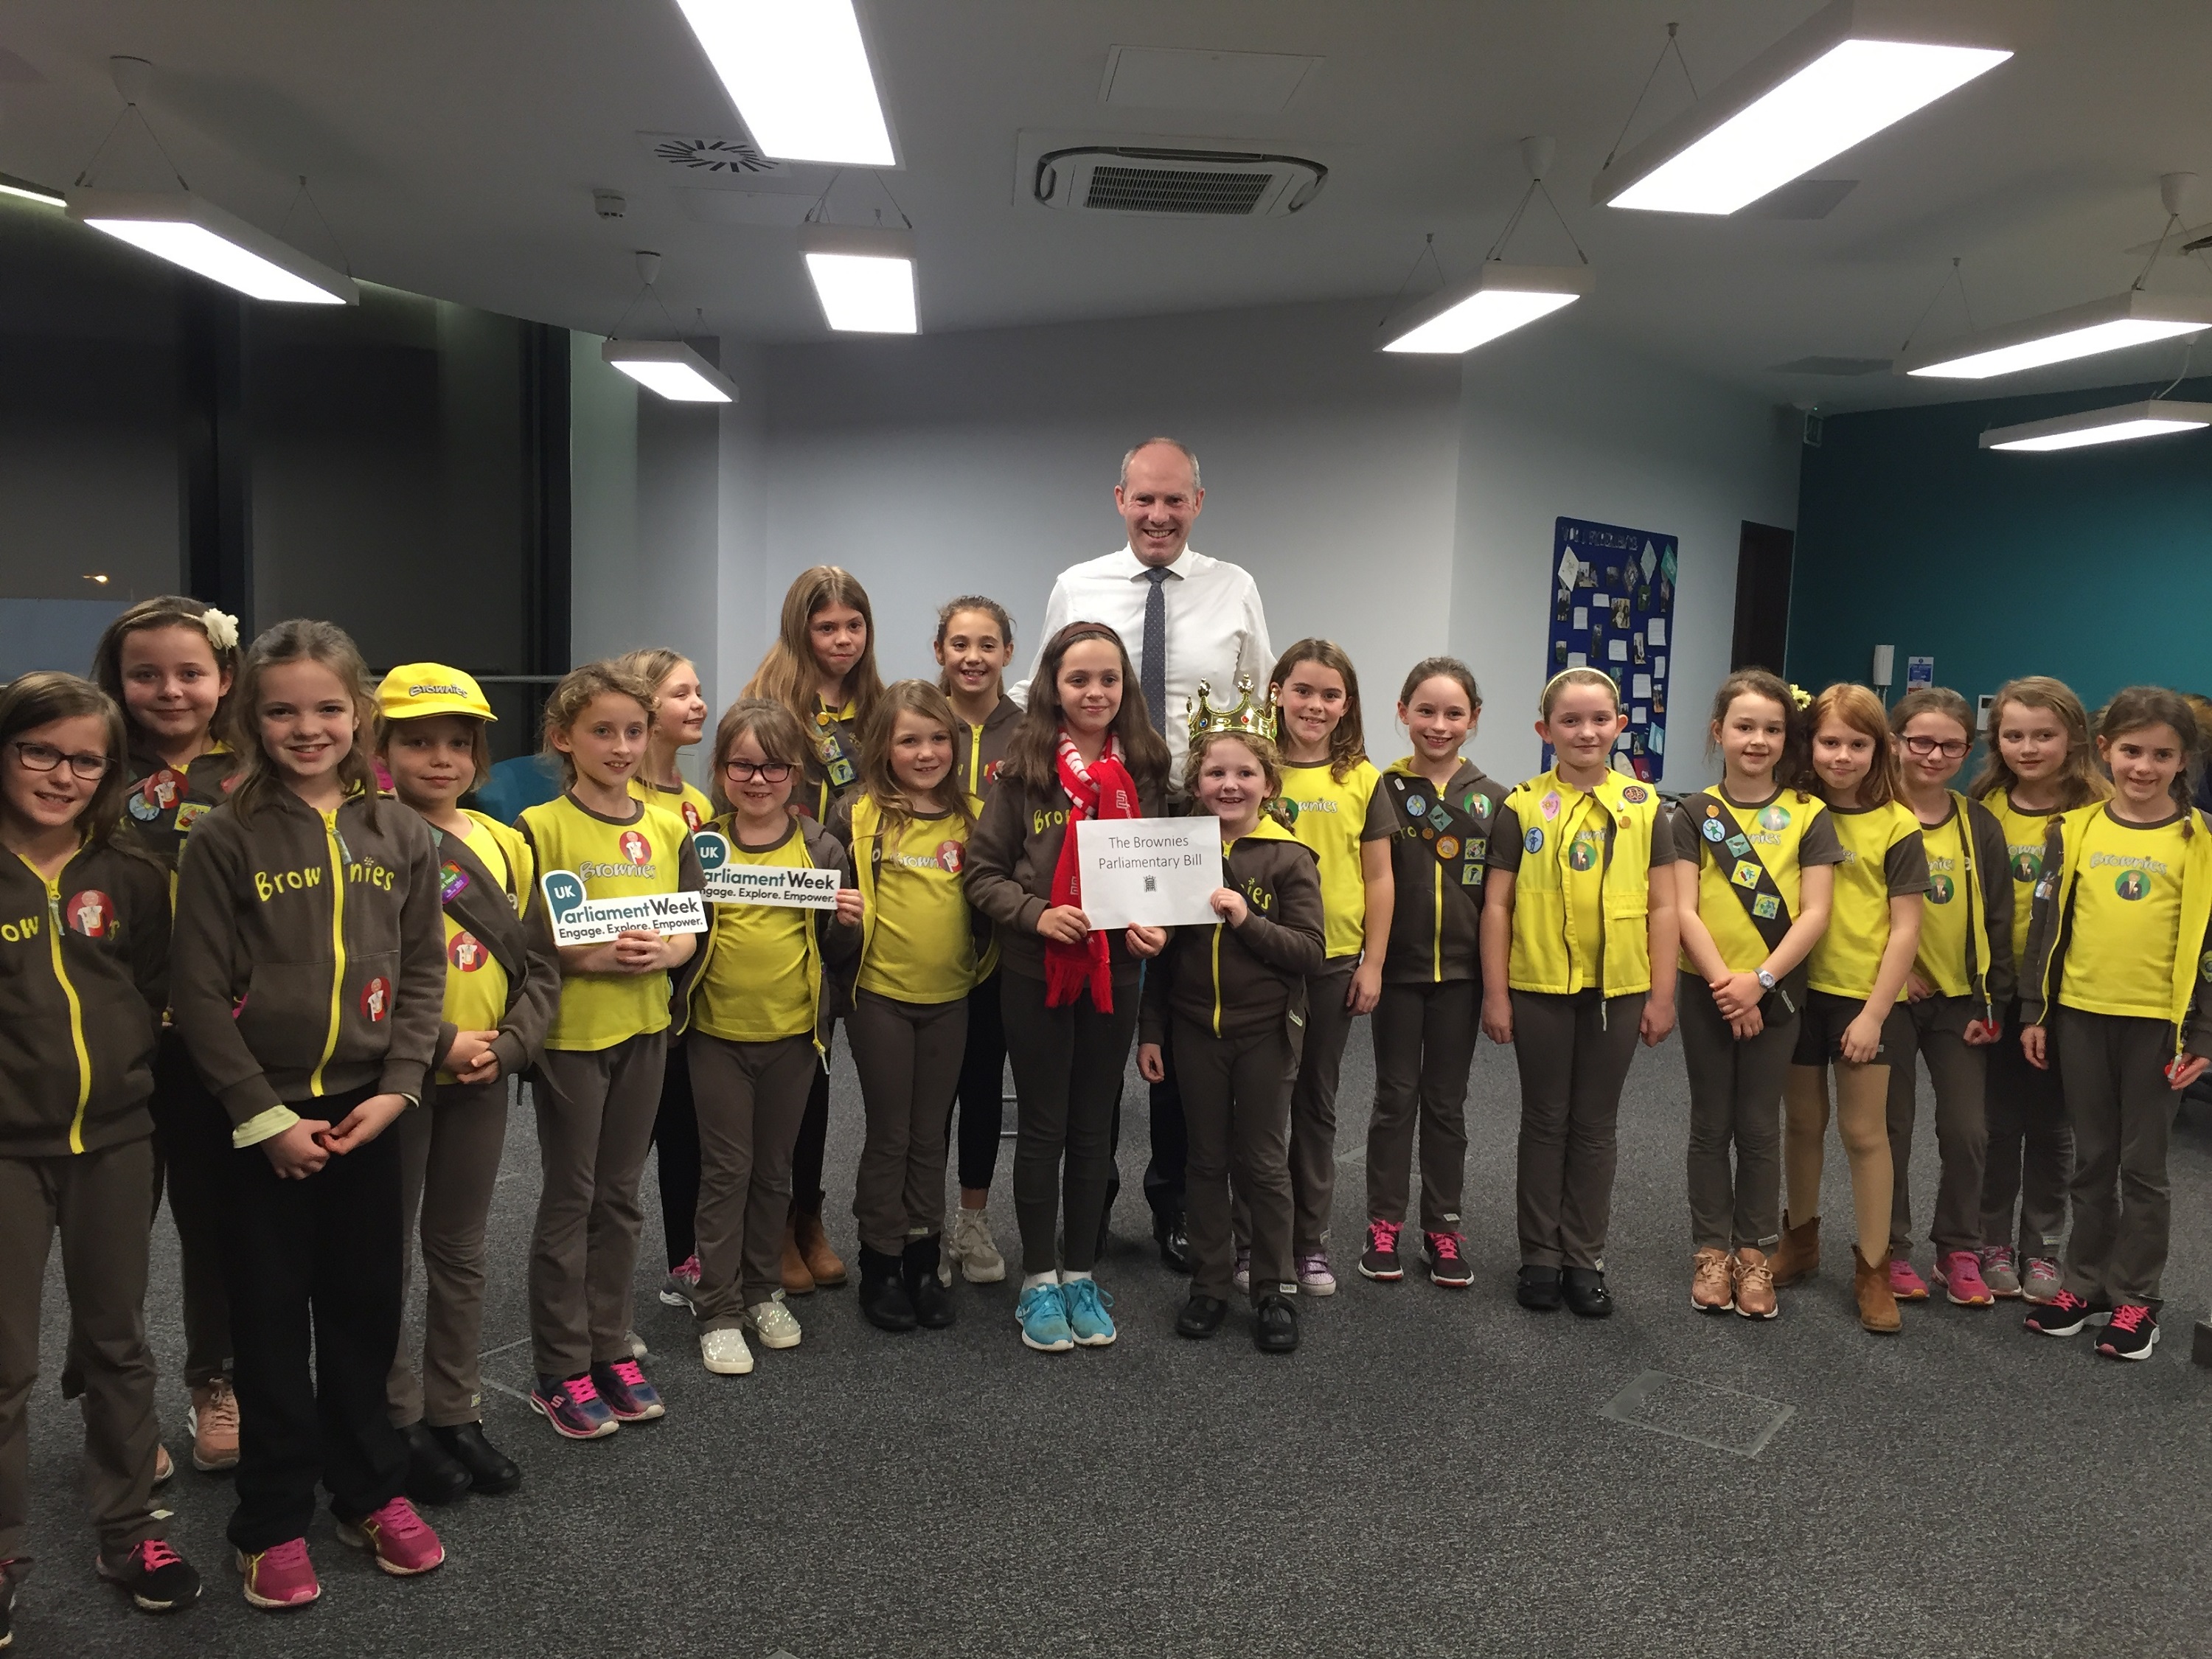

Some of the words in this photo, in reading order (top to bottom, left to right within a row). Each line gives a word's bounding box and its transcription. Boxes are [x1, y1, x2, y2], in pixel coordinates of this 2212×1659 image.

[408, 683, 467, 698] Brownies
[1298, 796, 1338, 813] wnies
[1109, 836, 1130, 849] The
[1134, 835, 1189, 848] Brownies
[580, 860, 655, 883] Brownies
[700, 846, 719, 858] UK
[787, 871, 835, 890] Week
[1099, 855, 1180, 869] Parliamentary
[1184, 854, 1202, 866] Bill
[2090, 851, 2167, 874] Brownies
[554, 885, 576, 900] UK
[650, 897, 700, 916] Week
[699, 887, 736, 899] ngage.
[739, 888, 781, 900] Explore.
[784, 891, 835, 903] Empower.
[559, 927, 605, 940] Engage.
[607, 922, 651, 933] Explore.
[653, 917, 703, 931] Empower.
